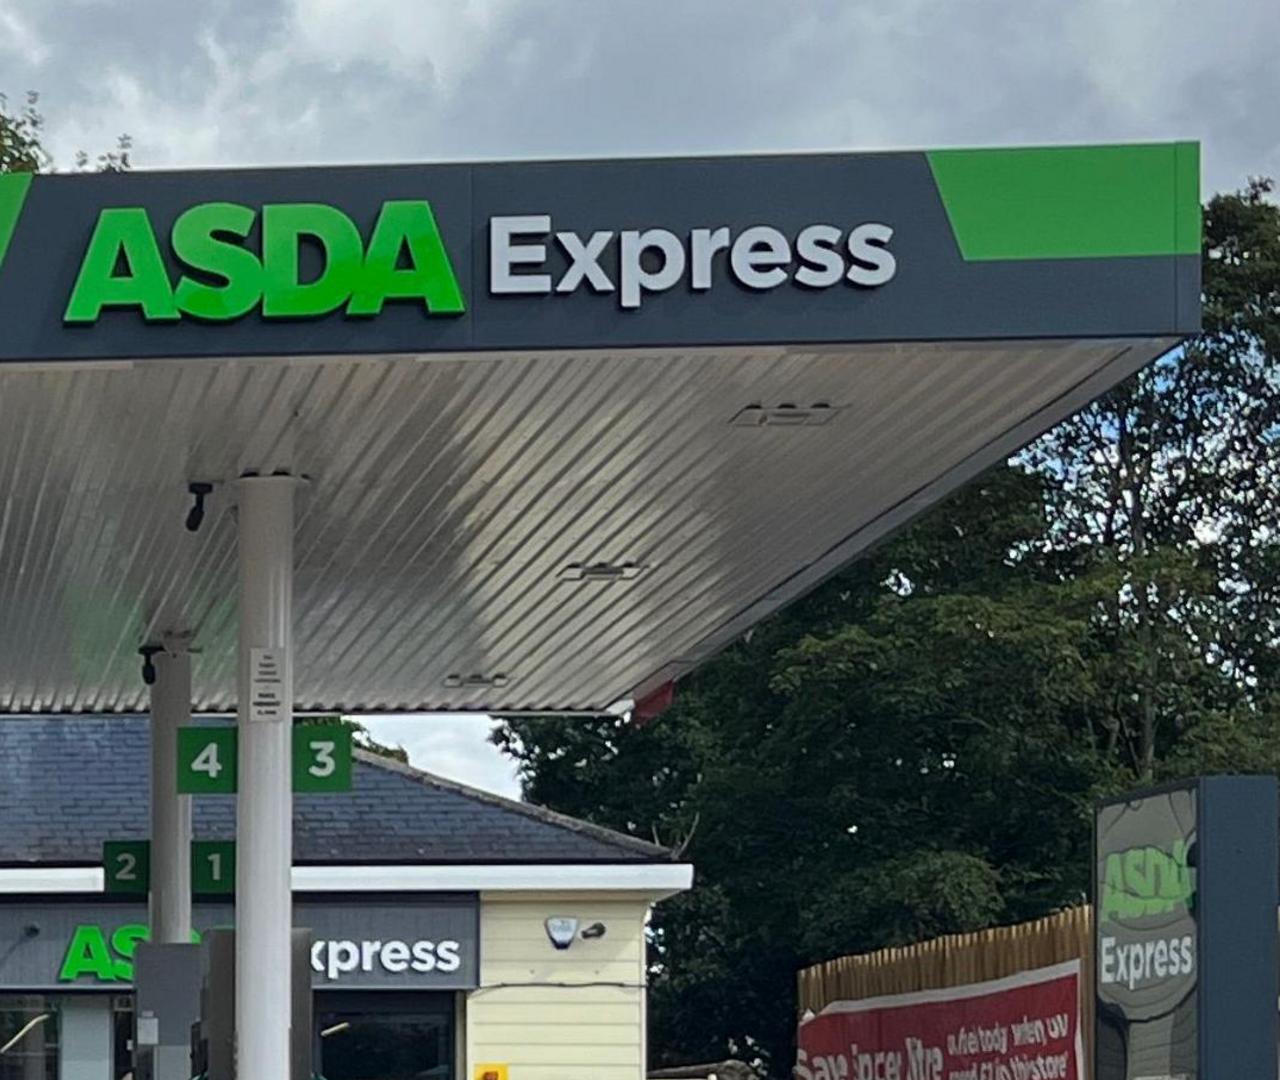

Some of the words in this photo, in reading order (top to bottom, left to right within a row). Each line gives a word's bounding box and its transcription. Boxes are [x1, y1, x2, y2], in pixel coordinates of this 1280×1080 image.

[64, 200, 466, 322] ASDA
[489, 215, 897, 308] Express
[190, 742, 222, 778] 4
[308, 741, 336, 777] 3
[115, 853, 136, 880] 2
[207, 853, 222, 881] 1
[1101, 936, 1193, 991] Express
